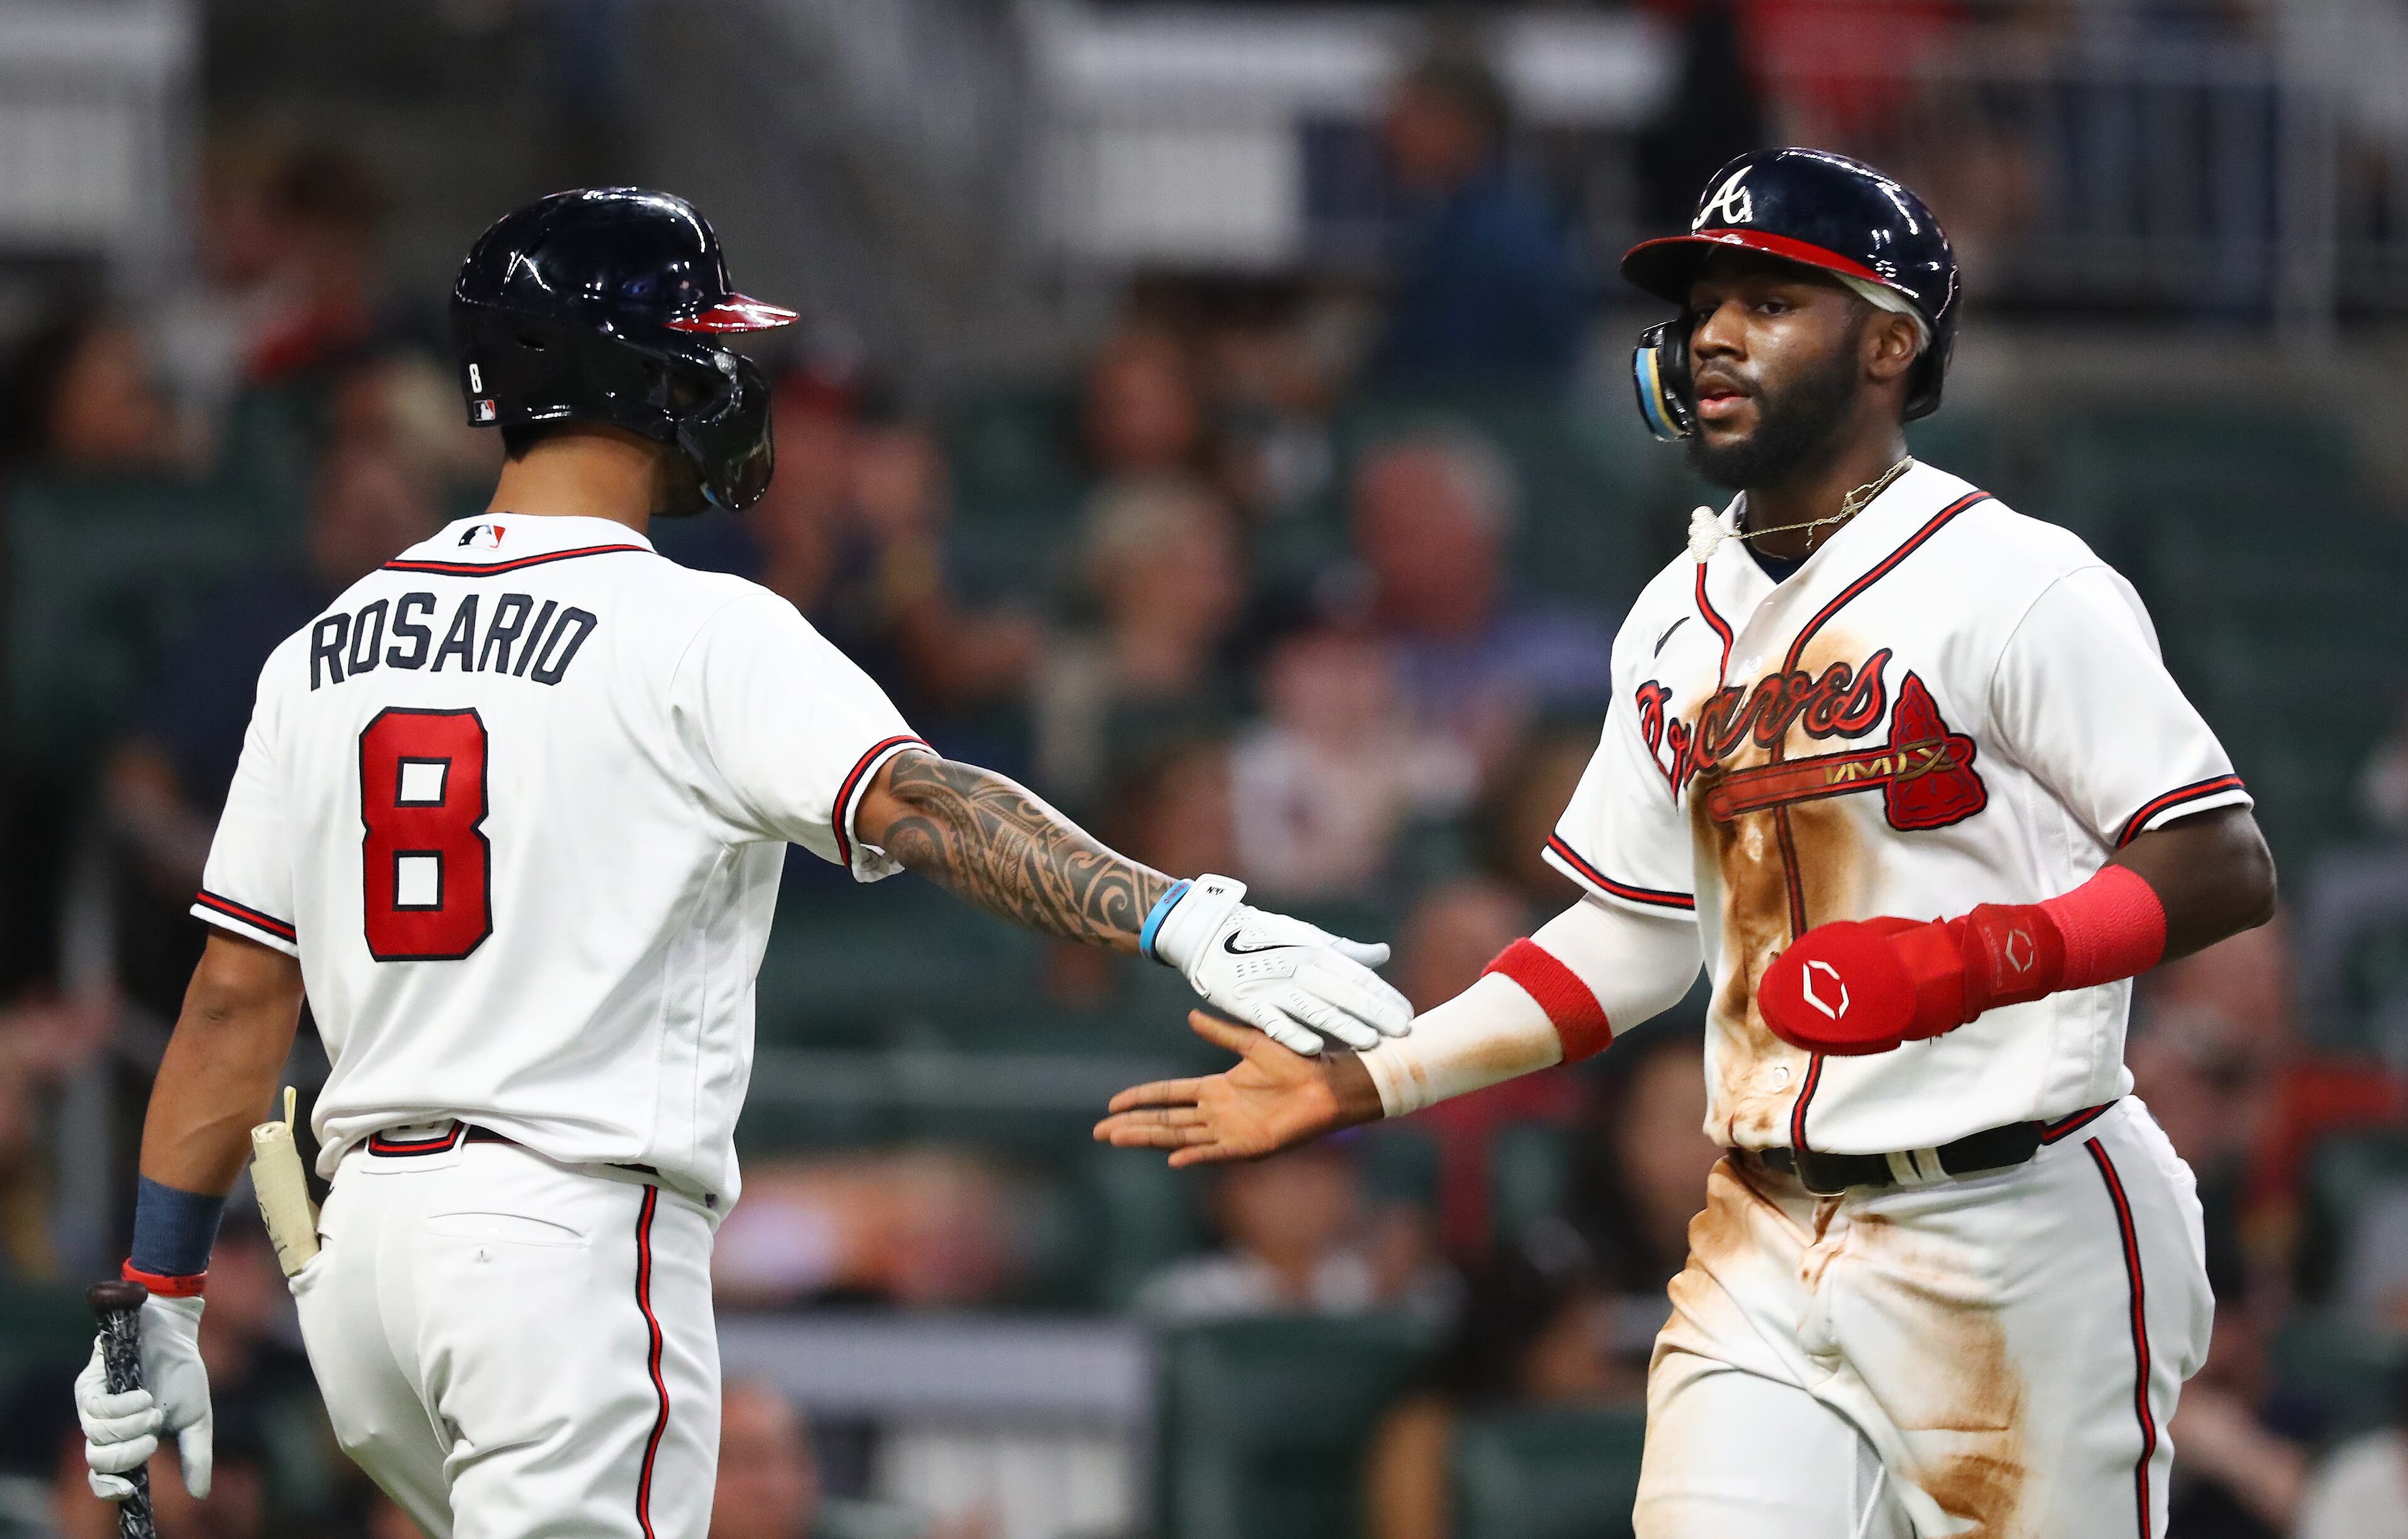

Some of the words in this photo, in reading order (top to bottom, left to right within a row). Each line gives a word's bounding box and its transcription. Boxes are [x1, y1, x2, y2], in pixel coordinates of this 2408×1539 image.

[1691, 164, 1753, 231] A
[468, 362, 483, 394] 8
[310, 592, 598, 692] ROSARIO
[358, 705, 494, 962] 8
